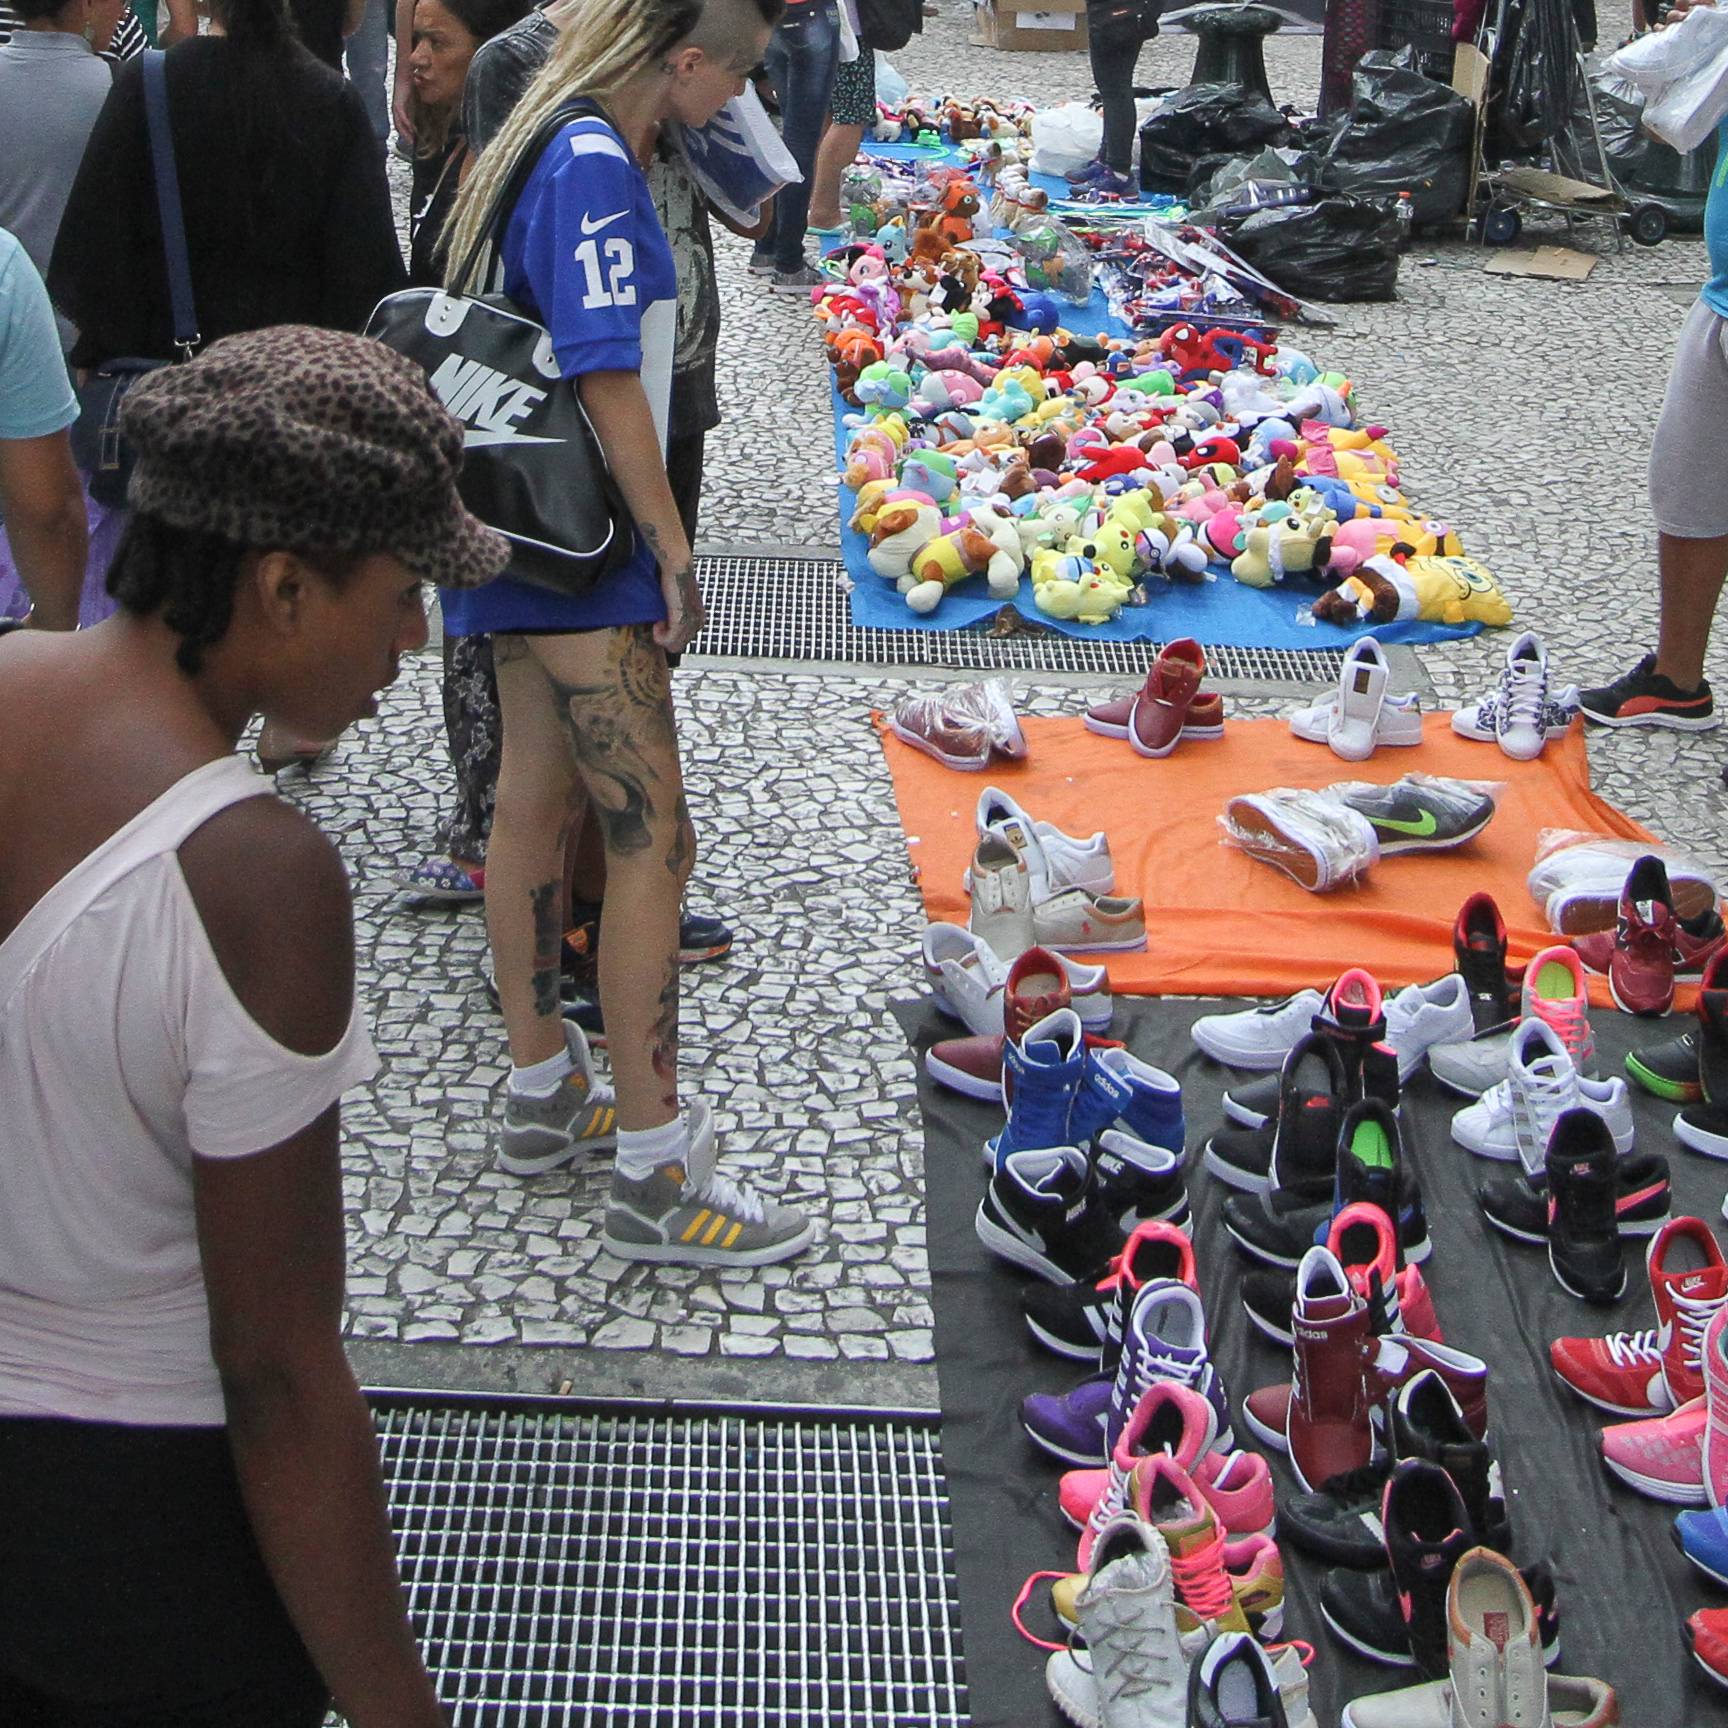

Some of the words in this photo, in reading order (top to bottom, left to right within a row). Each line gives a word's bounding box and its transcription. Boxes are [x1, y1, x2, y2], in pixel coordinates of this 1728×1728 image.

[574, 237, 636, 309] 12
[429, 353, 548, 434] NIKE
[1094, 1072, 1121, 1099] adidas
[1097, 1153, 1125, 1175] NIKE
